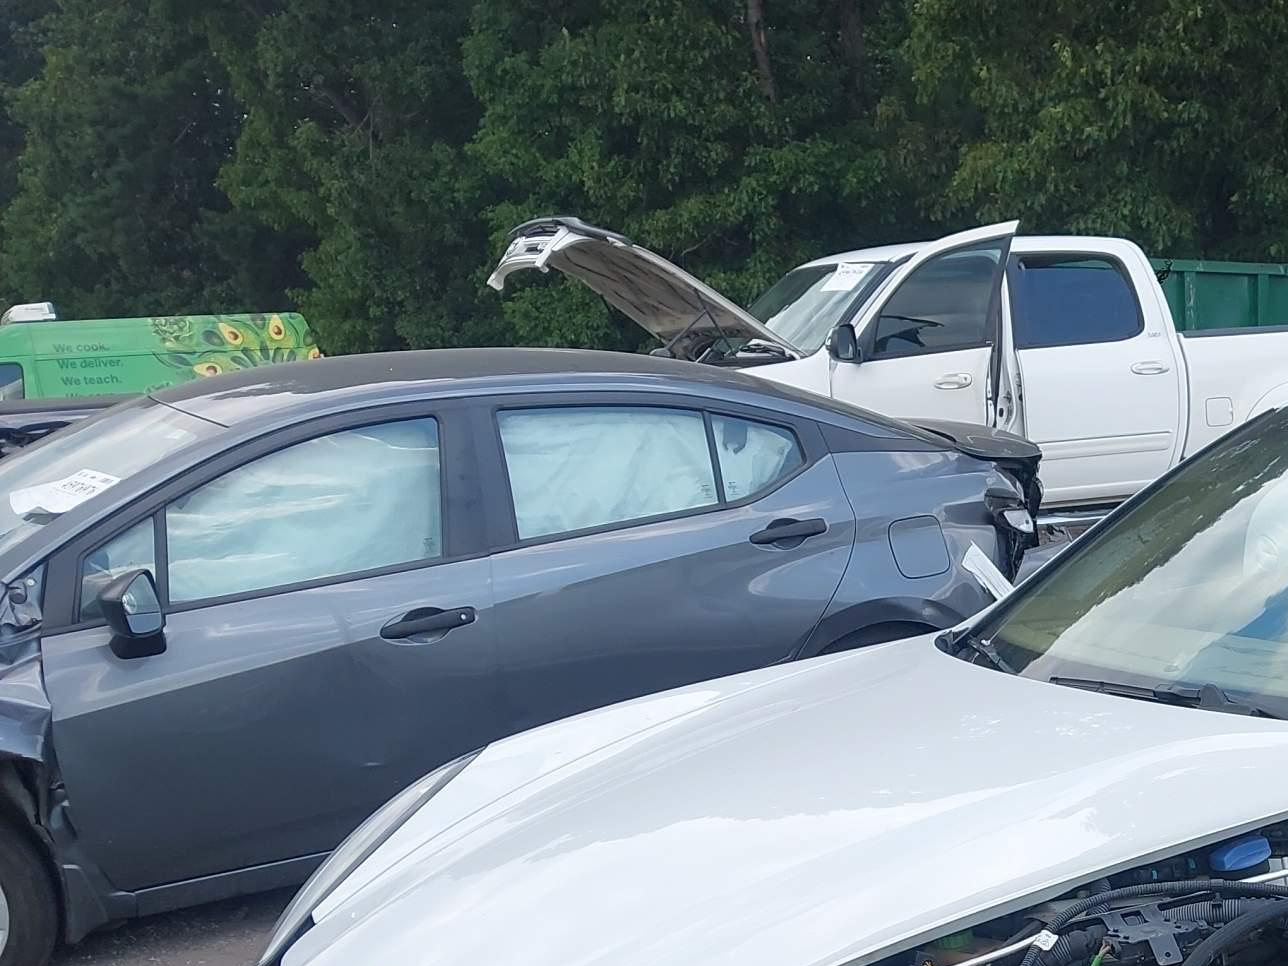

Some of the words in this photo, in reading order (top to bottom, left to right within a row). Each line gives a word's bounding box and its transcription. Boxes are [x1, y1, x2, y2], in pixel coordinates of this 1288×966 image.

[52, 343, 72, 353] We
[76, 342, 110, 352] cook.
[56, 359, 77, 369] We
[80, 358, 124, 369] deliver.
[61, 376, 81, 386] We
[83, 374, 122, 385] teach.
